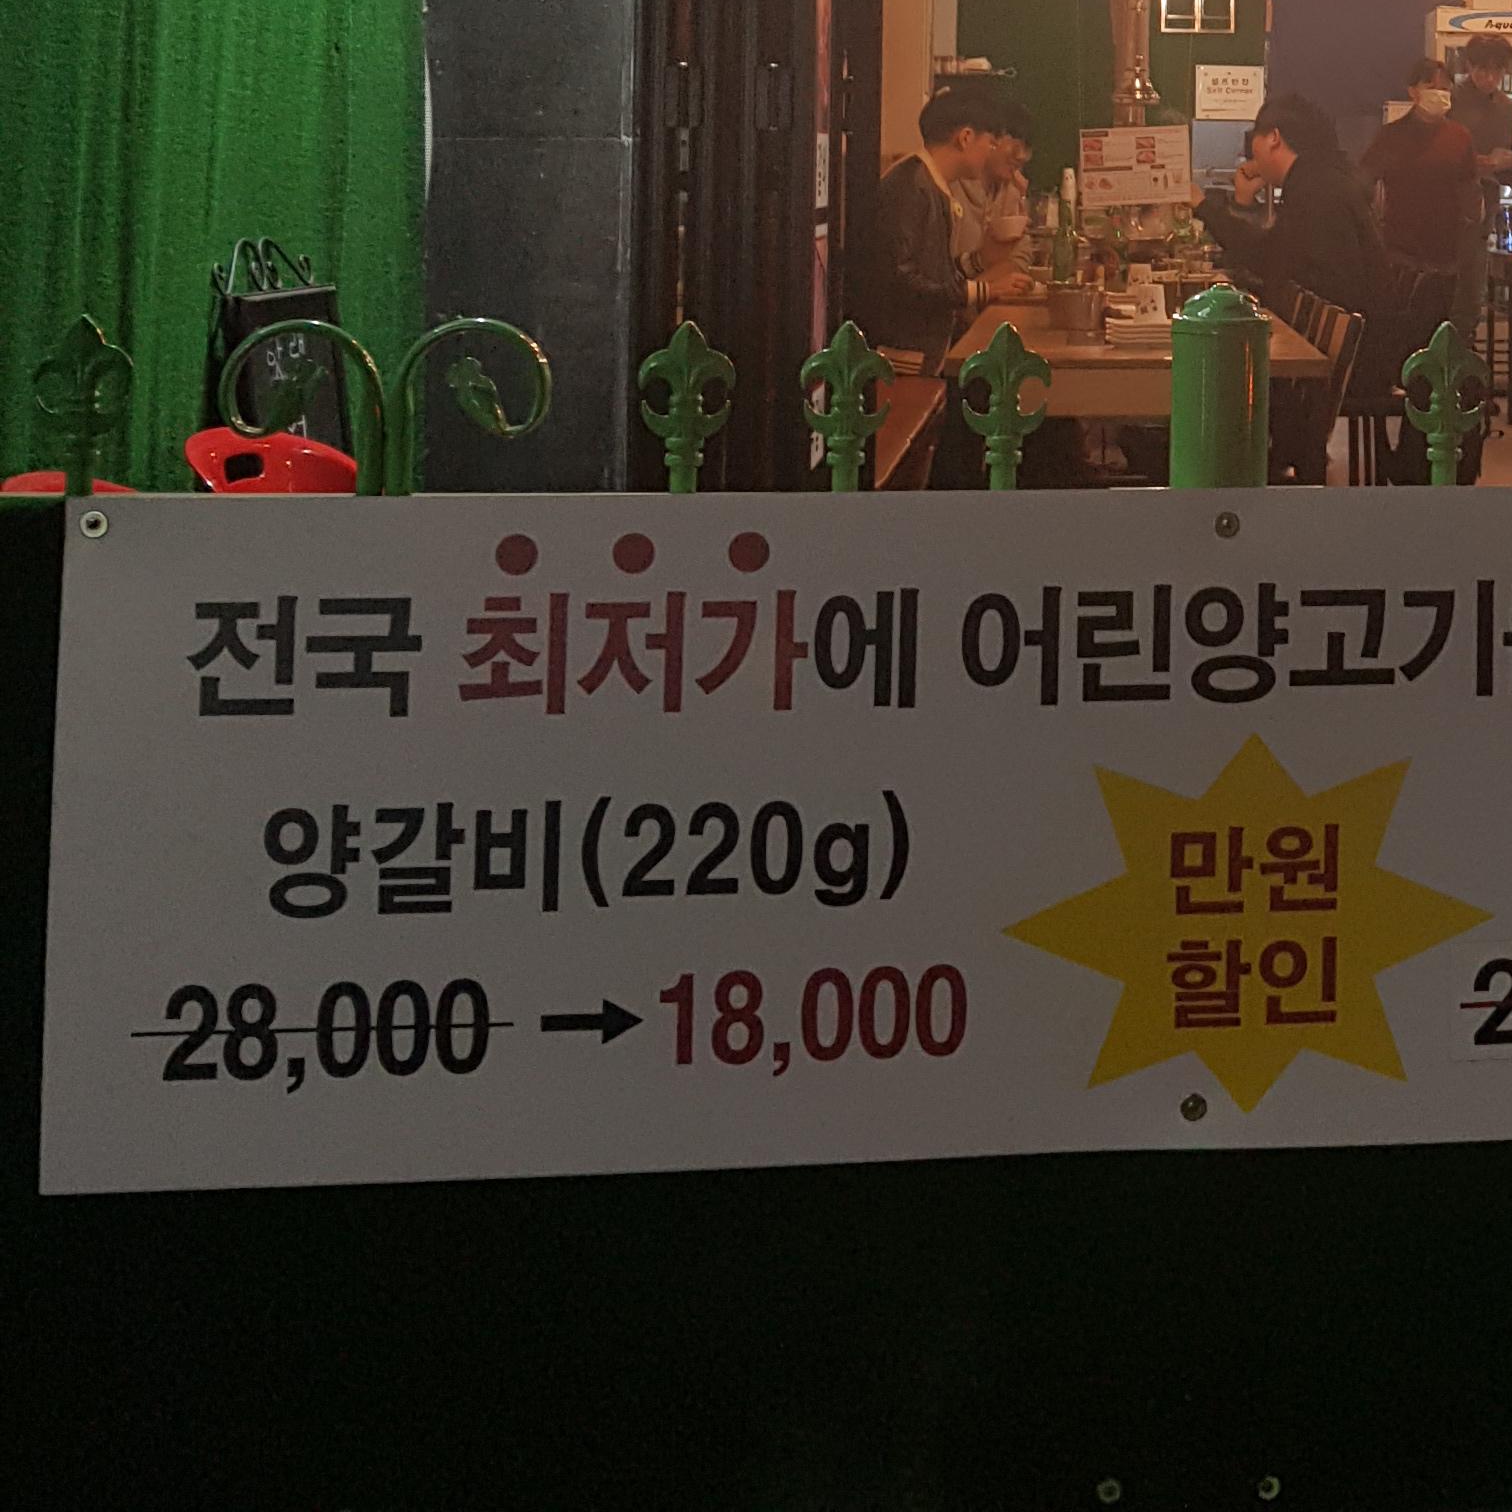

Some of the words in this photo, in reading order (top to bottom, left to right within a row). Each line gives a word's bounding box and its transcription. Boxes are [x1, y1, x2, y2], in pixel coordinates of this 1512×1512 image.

[187, 596, 422, 717] 전국
[459, 588, 919, 714] 최저가에
[265, 790, 909, 918] 양갈비(220g)
[1167, 823, 1341, 918] 만원
[162, 978, 491, 1094] 28,000
[660, 964, 967, 1076] 18,000
[1166, 934, 1340, 1030] 할인
